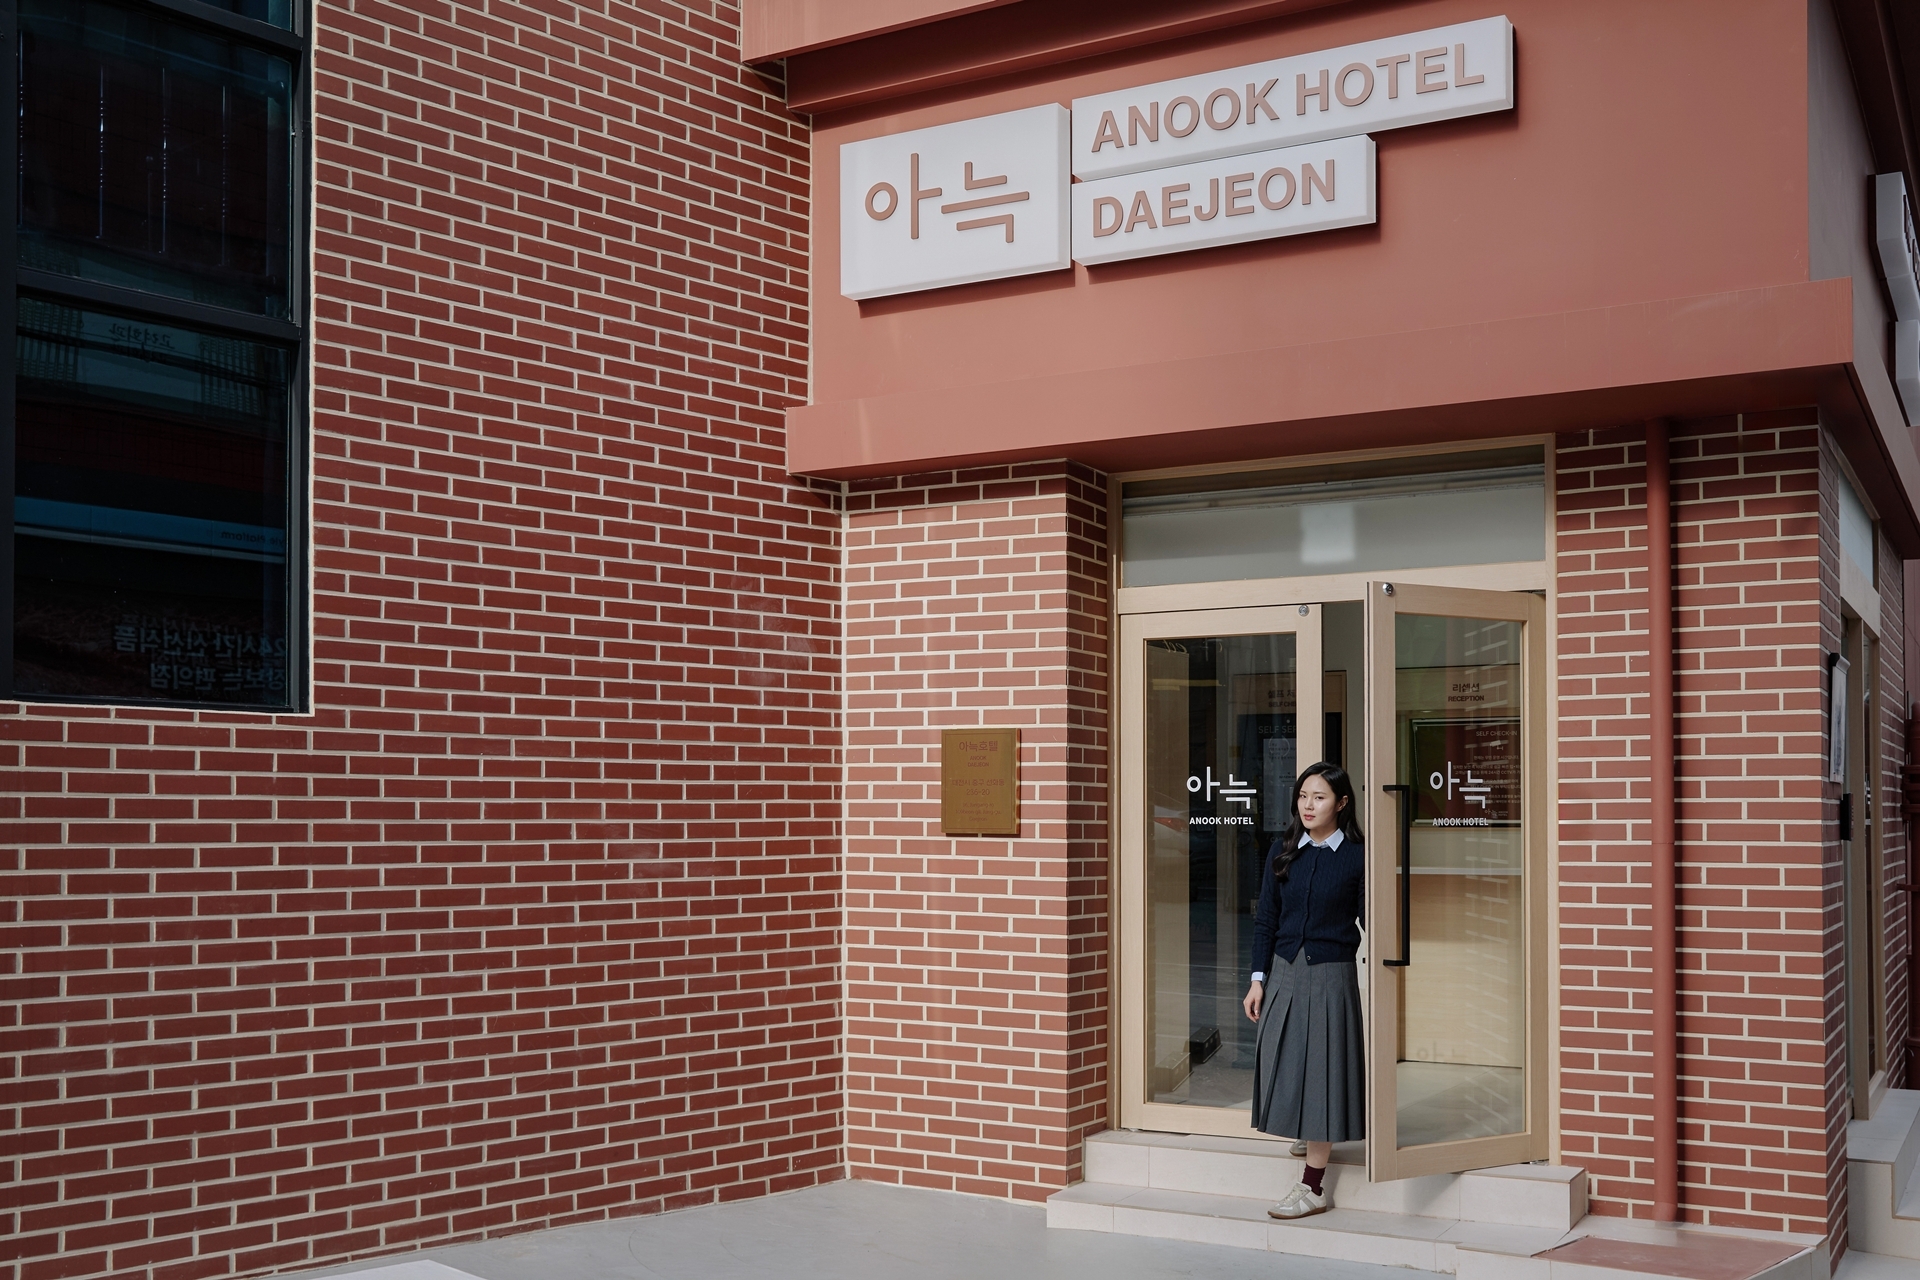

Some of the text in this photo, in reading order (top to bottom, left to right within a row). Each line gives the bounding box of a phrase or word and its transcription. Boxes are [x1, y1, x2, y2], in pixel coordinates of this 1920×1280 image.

[1090, 42, 1486, 154] ANOOK HOTEL
[864, 152, 1031, 245] 아늑
[1091, 158, 1337, 240] DAEJEON
[1452, 683, 1480, 693] 리셉션
[1258, 725, 1280, 734] SELF
[958, 740, 998, 752] 아늑호텔
[1186, 766, 1258, 810] 아늑
[1429, 761, 1492, 810] 아늑
[1188, 816, 1254, 826] ANOOK HOTEL
[1432, 817, 1489, 827] ANOOK HOTEL
